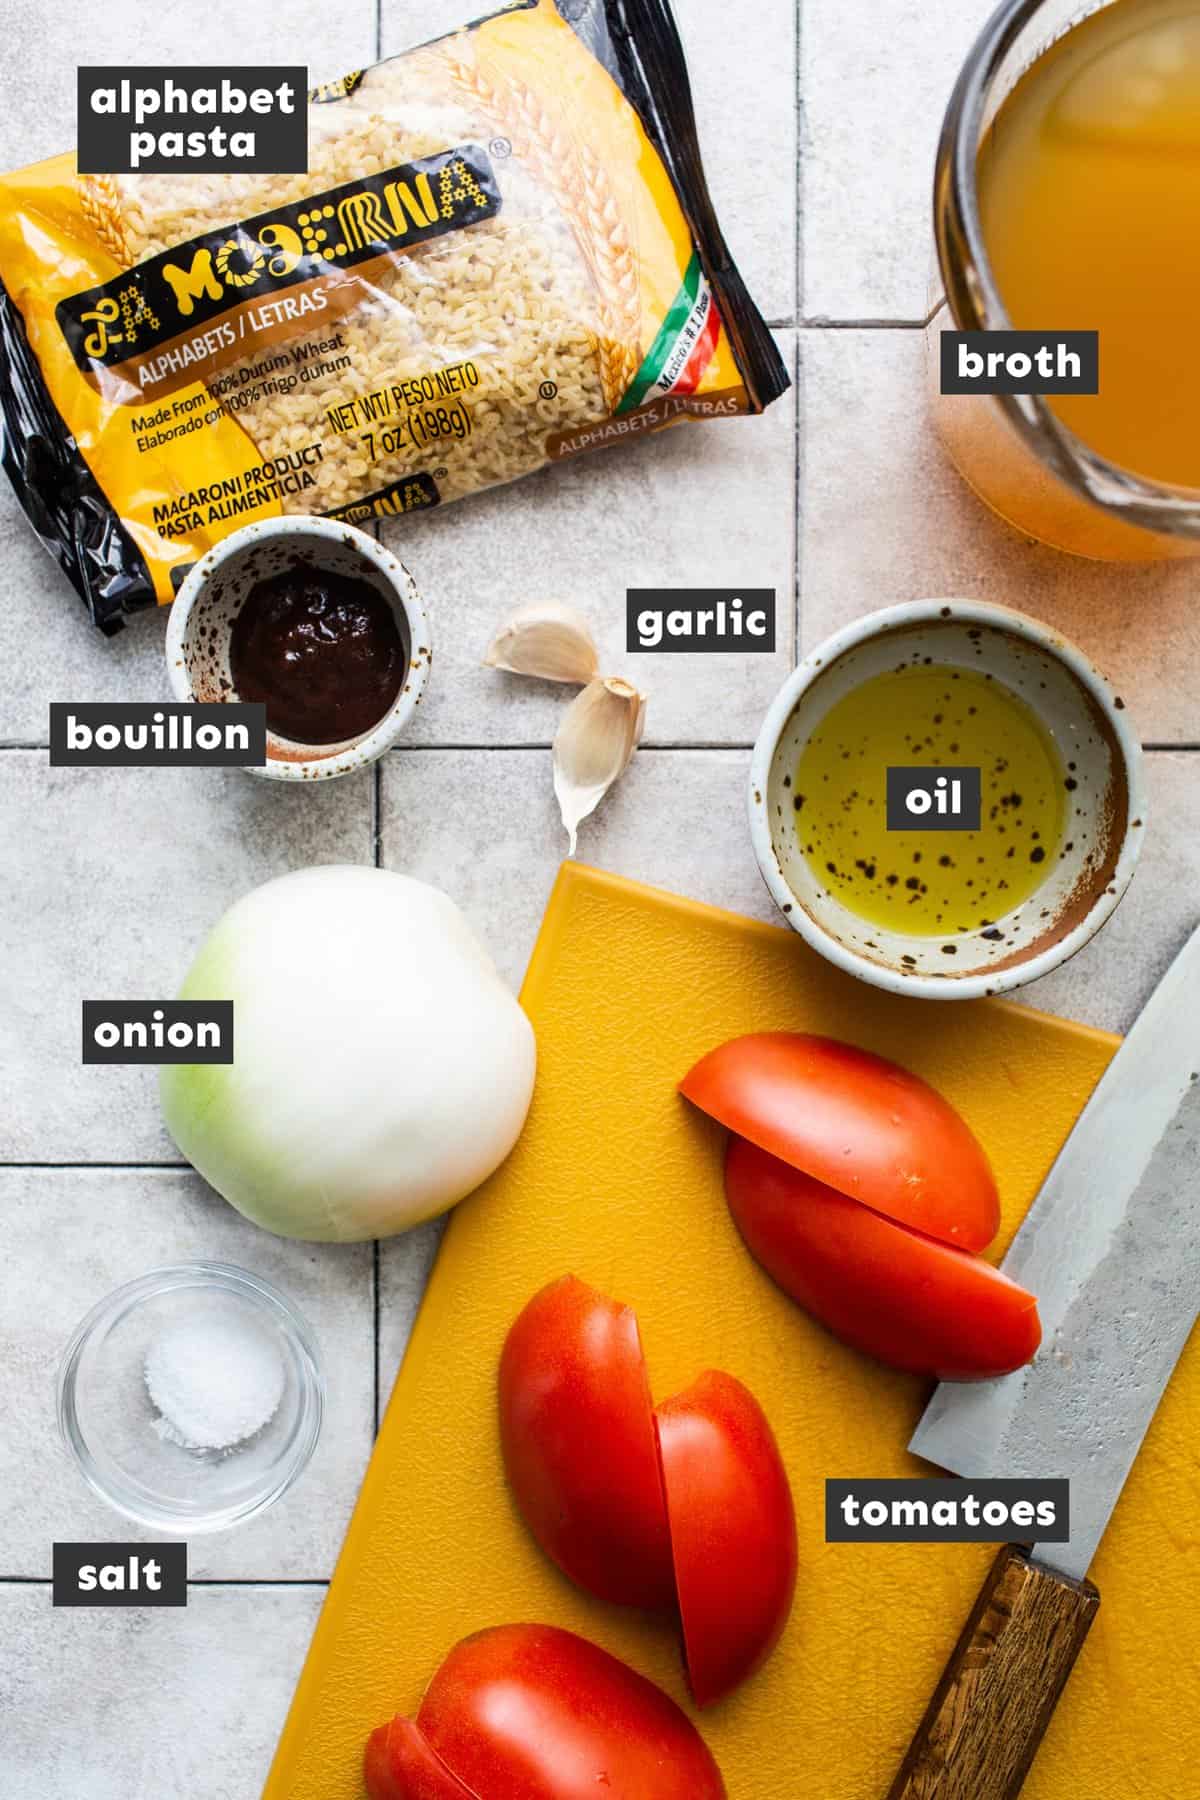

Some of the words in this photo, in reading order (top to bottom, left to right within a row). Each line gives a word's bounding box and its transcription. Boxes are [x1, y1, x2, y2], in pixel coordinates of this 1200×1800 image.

[81, 285, 160, 358] LA
[162, 160, 488, 315] MODERNA
[138, 322, 235, 387] ALPHABETS
[250, 288, 328, 333] LETRAS
[657, 337, 691, 391] Mexico's
[131, 408, 171, 433] Made
[172, 393, 206, 416] From
[206, 374, 239, 399] 100%
[239, 355, 290, 384] Durum
[291, 333, 345, 362] Wheat
[137, 418, 203, 452] Elaborado
[204, 404, 226, 425] con
[225, 387, 260, 414] 100%
[259, 374, 298, 395] Trigo
[300, 355, 352, 383] durum
[327, 403, 359, 434] NET
[359, 389, 391, 422] WT/
[391, 377, 434, 409] PESO
[435, 362, 479, 396] NETO
[361, 433, 376, 461] 7
[382, 427, 407, 454] oz
[407, 400, 471, 449] (198g)
[559, 408, 659, 456] ALPHABETS
[153, 477, 242, 523] MACARONI
[244, 443, 324, 489] PRODUCT
[157, 512, 205, 539] PASTA
[208, 471, 317, 523] ALIMENTICIA
